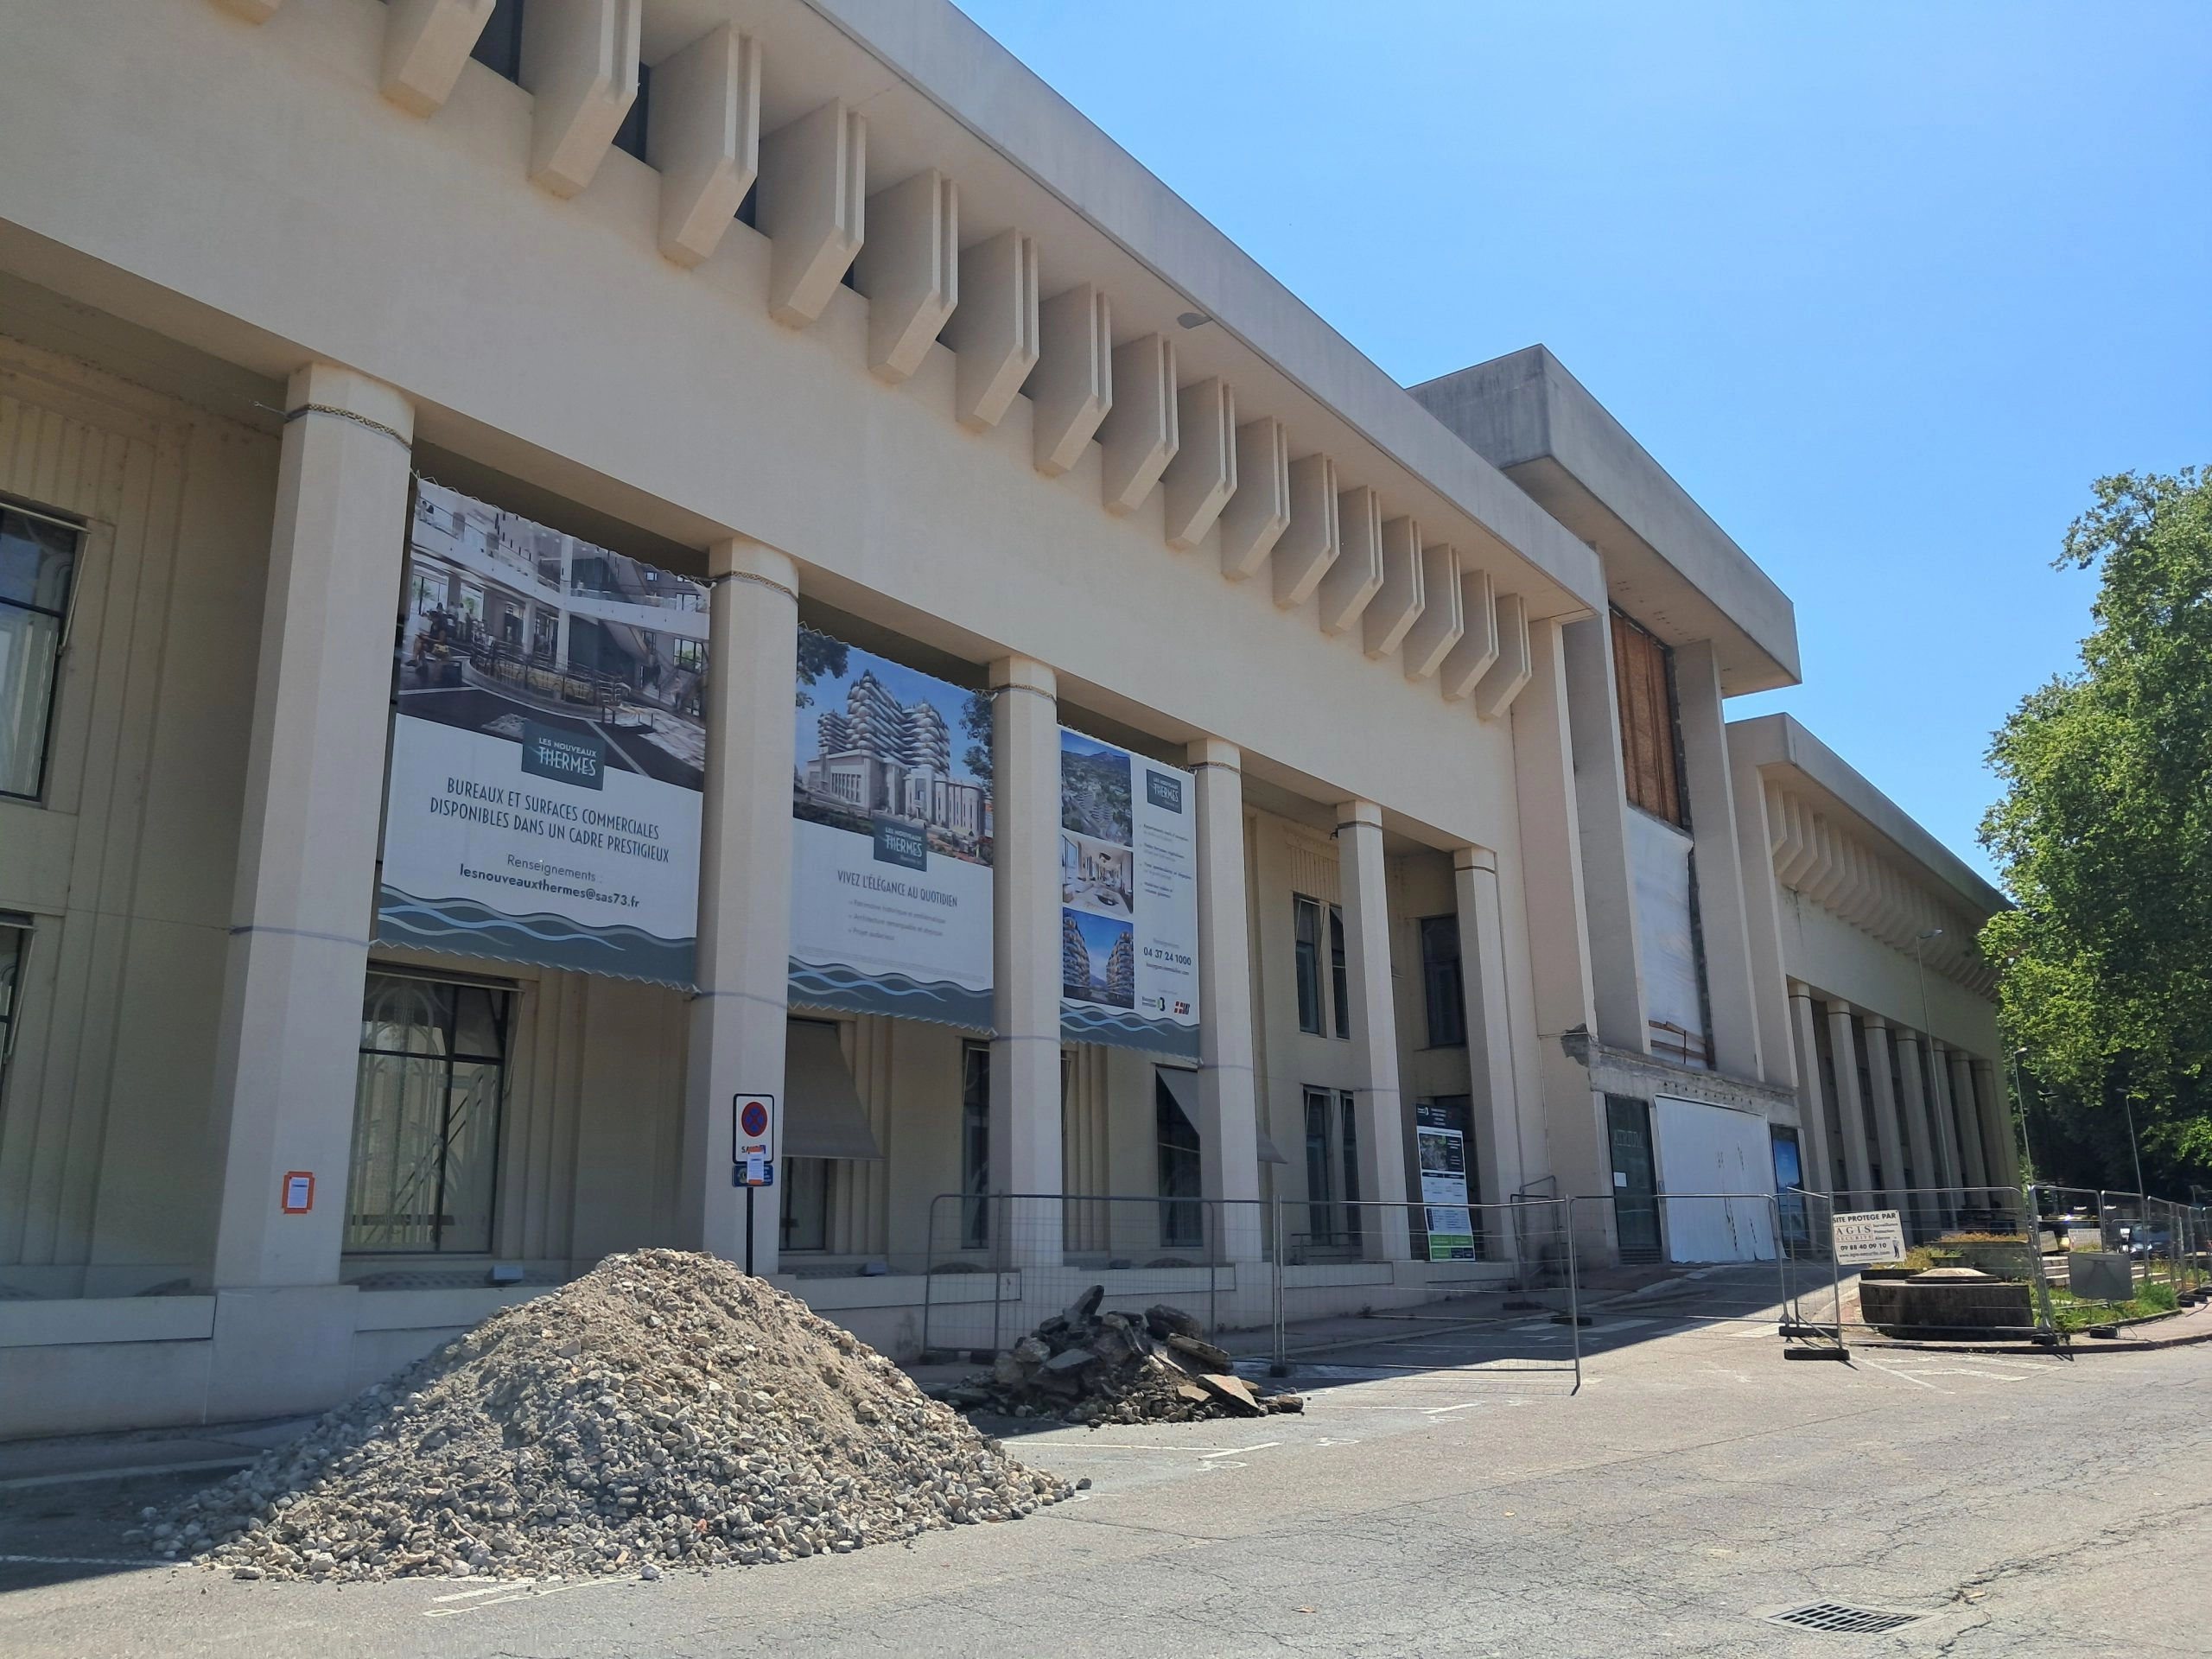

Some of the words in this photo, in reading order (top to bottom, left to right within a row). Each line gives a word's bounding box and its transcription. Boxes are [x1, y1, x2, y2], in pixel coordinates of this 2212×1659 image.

[539, 737, 552, 747] LES
[554, 741, 597, 758] NOUVEAUX
[538, 746, 596, 777] THERMES
[448, 777, 503, 804] BUREAUX
[508, 791, 521, 808] ET
[524, 795, 578, 822] SURFACES
[582, 809, 659, 840] COMMERCIALES
[430, 797, 509, 829] DISPONIBLES
[513, 815, 544, 836] DANS
[549, 823, 565, 841] UN
[569, 828, 603, 849] CADRE
[607, 836, 670, 863] PRESTIGIEUX
[886, 834, 922, 857] THERMES
[507, 855, 596, 882] Renseignements
[460, 863, 640, 908] lesnouveauxthermes@sas73.fr
[837, 870, 861, 887] VIVEZ
[862, 874, 906, 896] L'ÉLÉGANCE
[907, 887, 918, 899] AU
[920, 888, 958, 907] QUOTIDIEN
[1143, 947, 1153, 957] 04
[1154, 950, 1163, 959] 37
[1165, 951, 1173, 962] 24
[1175, 954, 1192, 965] 1000
[1836, 1225, 1871, 1235] AGIS
[1847, 1213, 1880, 1222] PROTEGE
